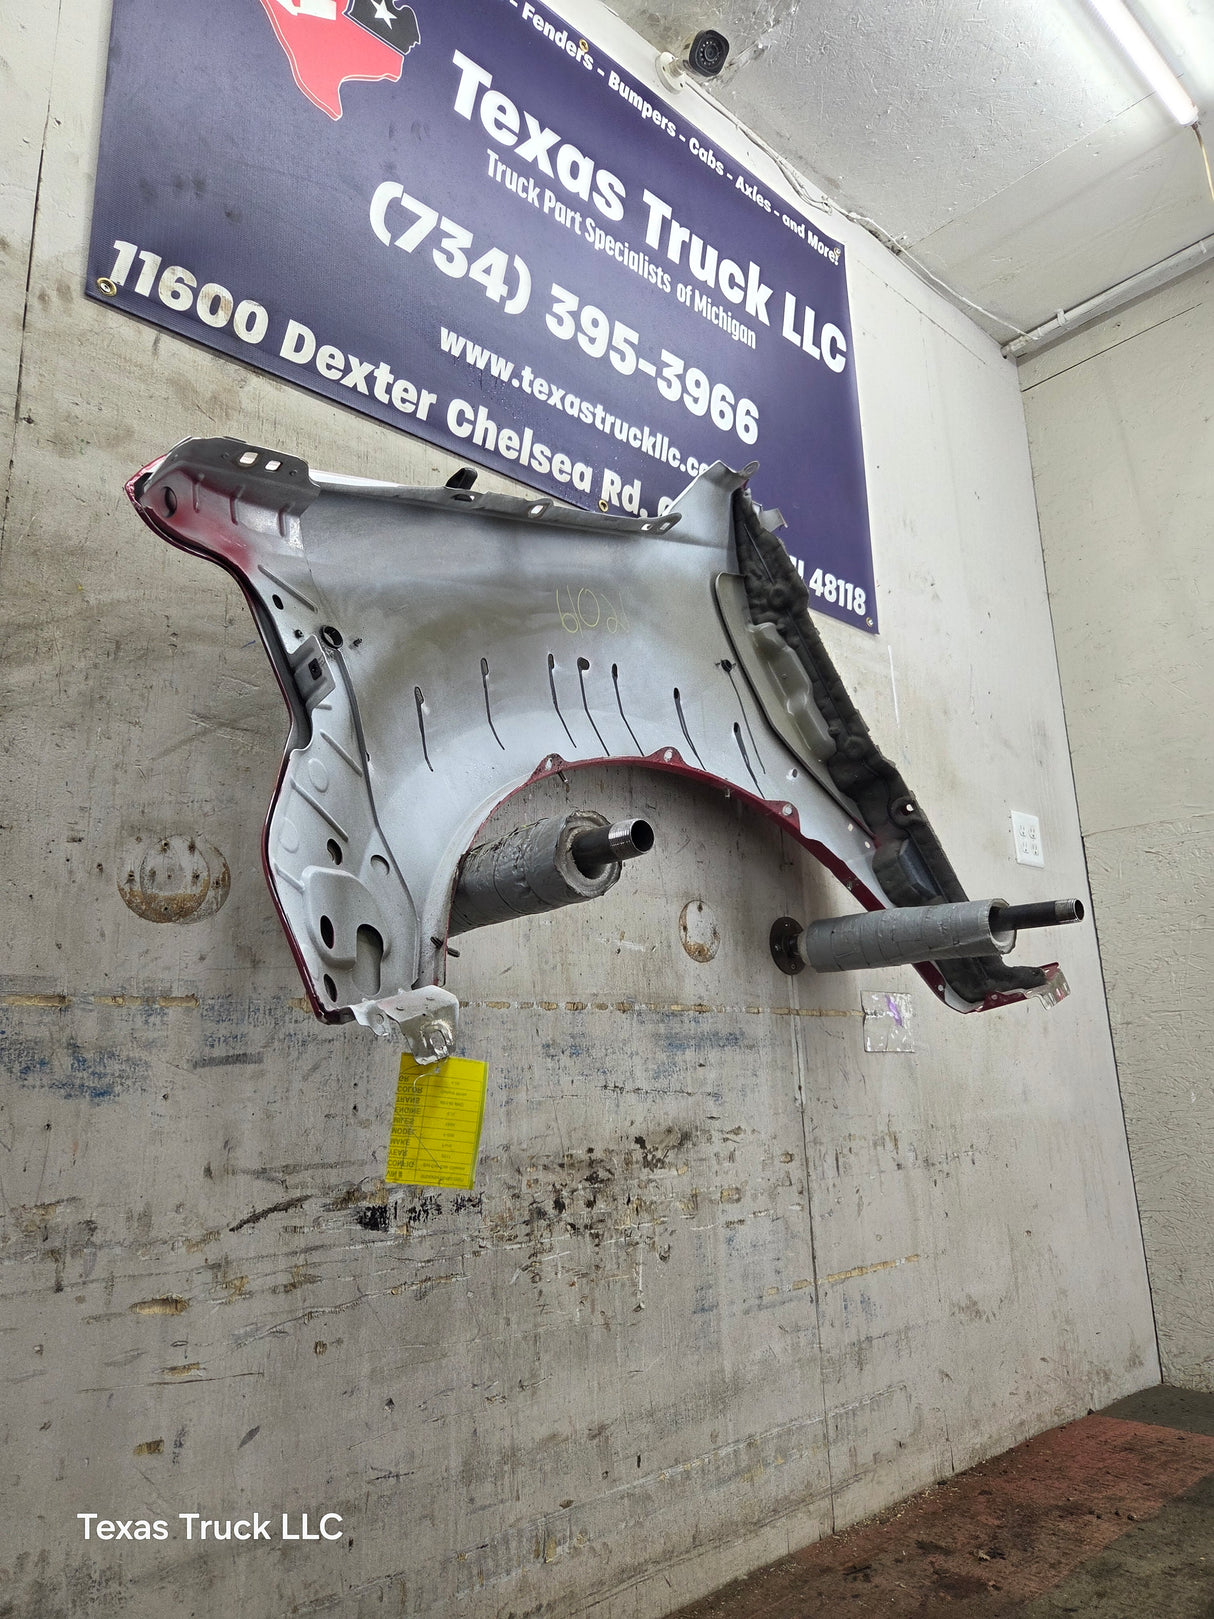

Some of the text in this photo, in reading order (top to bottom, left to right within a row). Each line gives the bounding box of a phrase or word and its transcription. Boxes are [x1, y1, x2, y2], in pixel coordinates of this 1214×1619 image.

[452, 49, 848, 374] Texas Truck LLC
[486, 148, 757, 350] Truck Part Specialists of Michigan
[521, 1, 595, 71] Fenders
[608, 70, 677, 138] Bumpers
[689, 137, 724, 176] Cabs
[735, 175, 772, 214] Axles
[782, 213, 806, 240] and
[807, 230, 840, 266] More!
[100, 239, 270, 345] 11600
[279, 318, 438, 422] Dexter
[446, 398, 594, 494] Chelsea
[600, 467, 648, 518] Rd.
[808, 567, 867, 616] 48118
[369, 180, 761, 446] (734) 395-3966
